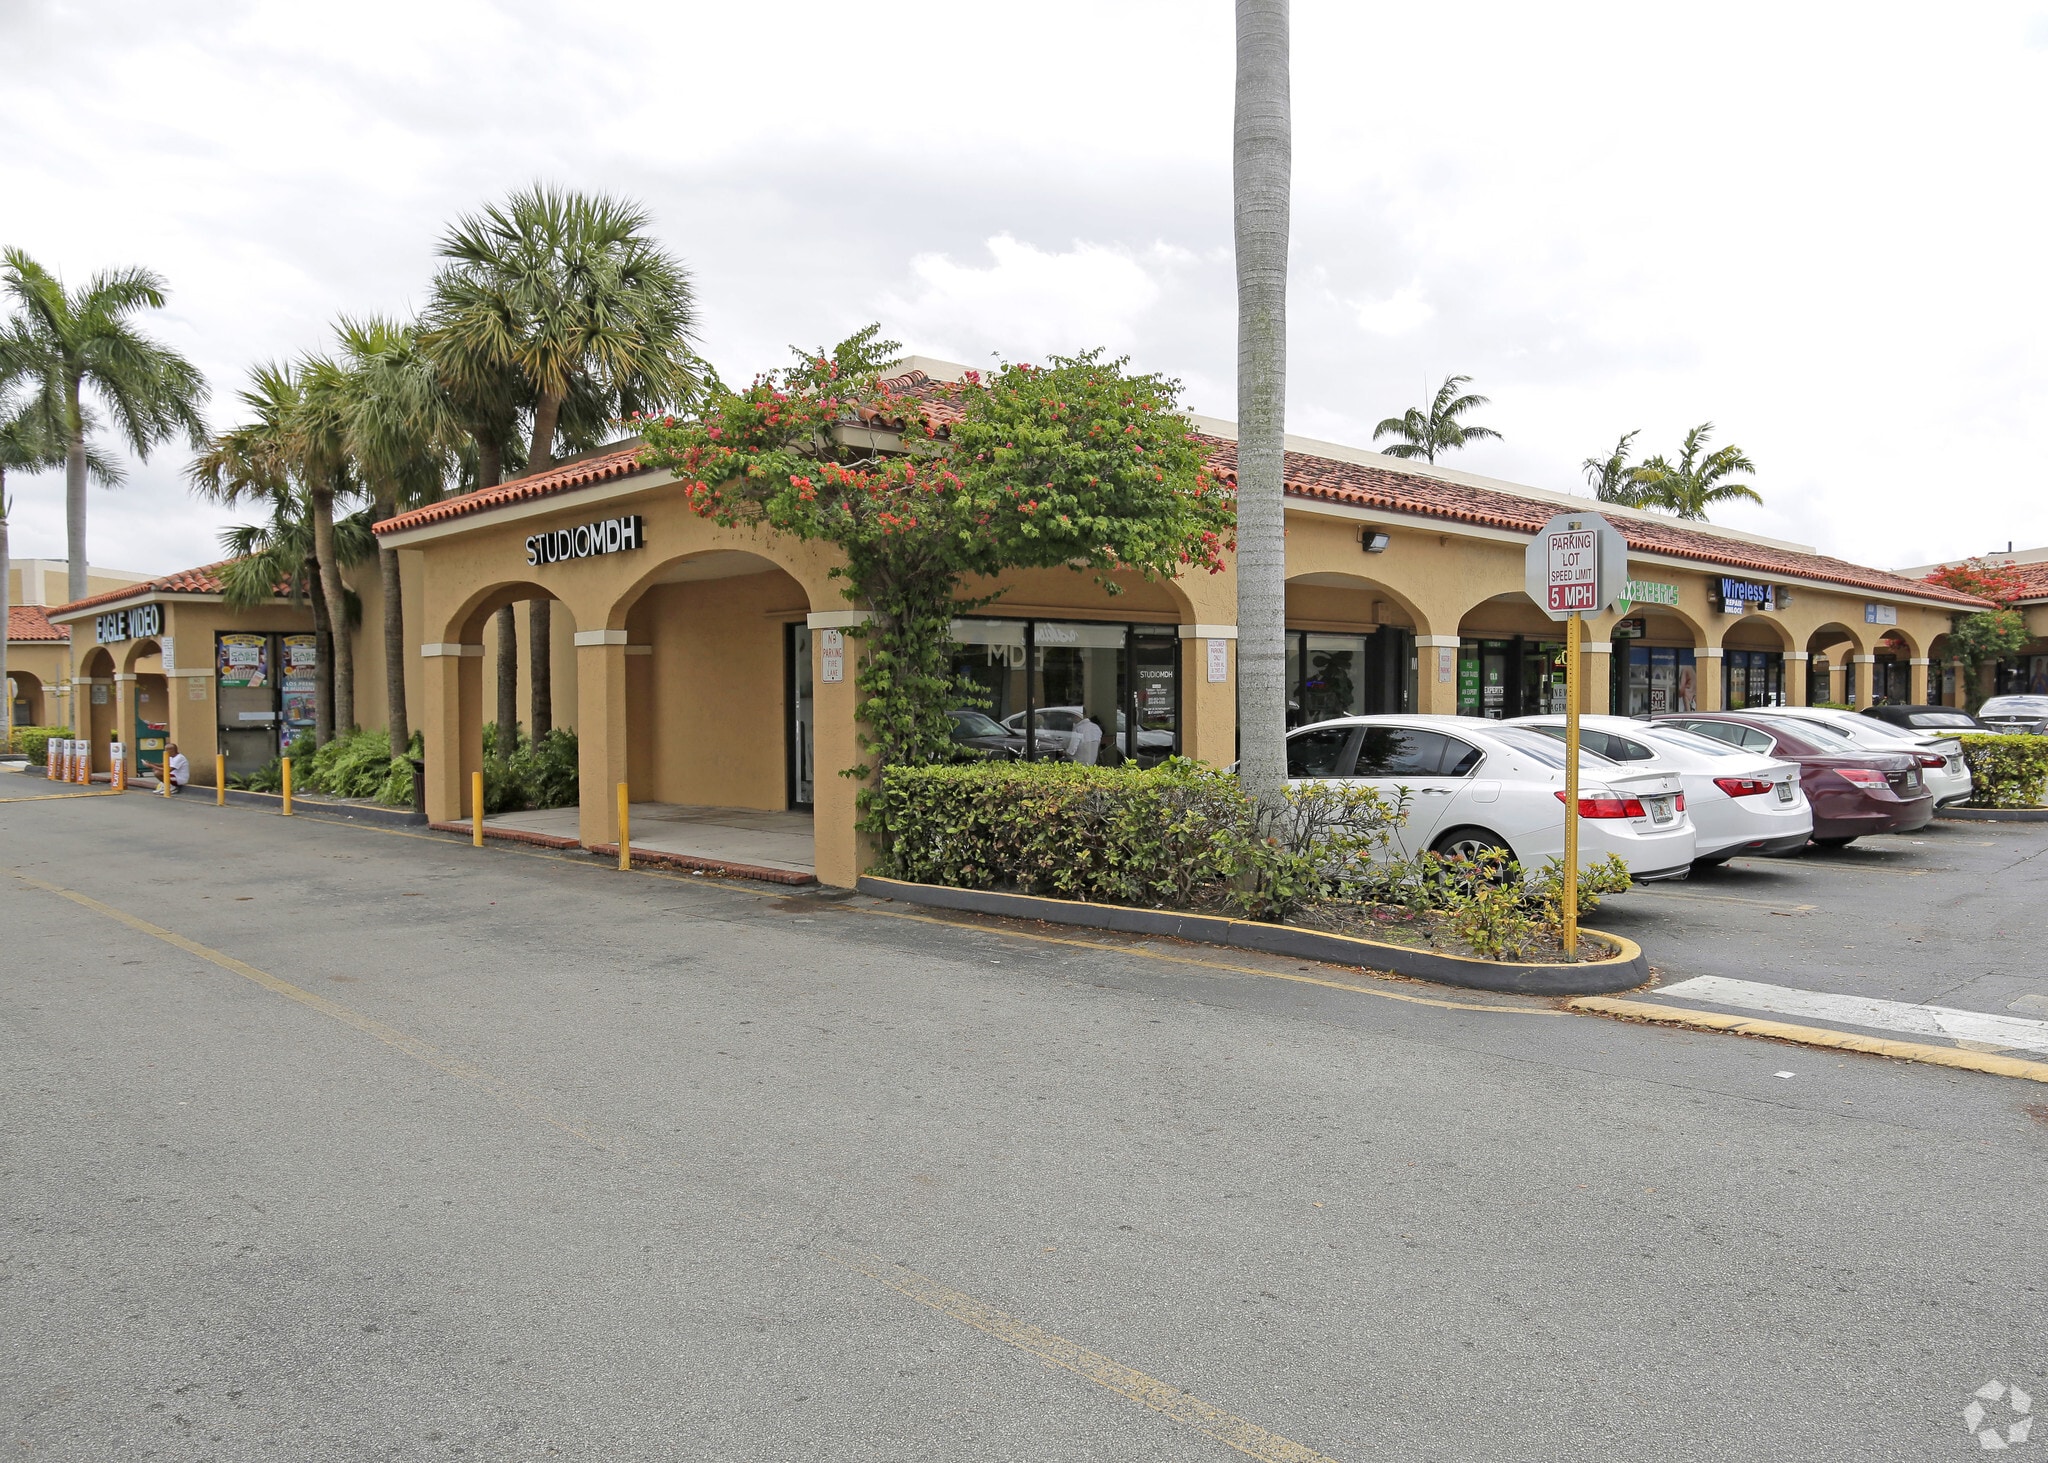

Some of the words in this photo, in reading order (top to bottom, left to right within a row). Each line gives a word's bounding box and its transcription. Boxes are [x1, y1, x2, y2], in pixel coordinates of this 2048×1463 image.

[525, 515, 636, 567] STUDIOMDH
[1552, 535, 1591, 551] PARKING
[1562, 553, 1580, 566] LOT
[1551, 570, 1573, 582] SPEED
[1575, 568, 1592, 580] LIMIT
[1635, 581, 1679, 605] EXPERTS
[1722, 578, 1764, 602] Wireless
[1766, 584, 1773, 602] 4
[1551, 587, 1560, 608] 5
[1564, 586, 1593, 607] MPH
[1725, 598, 1743, 607] REPAIR
[1725, 606, 1743, 614] UNLOCK
[96, 611, 126, 644] EAGLE
[128, 604, 159, 638] VIDEO
[827, 634, 837, 645] NO
[823, 648, 843, 658] PARKING
[987, 644, 1044, 672] MDH
[827, 669, 838, 677] LANE
[1140, 670, 1173, 679] STUDIOMDH
[1651, 690, 1664, 700] FOR
[1651, 701, 1665, 710] SALE
